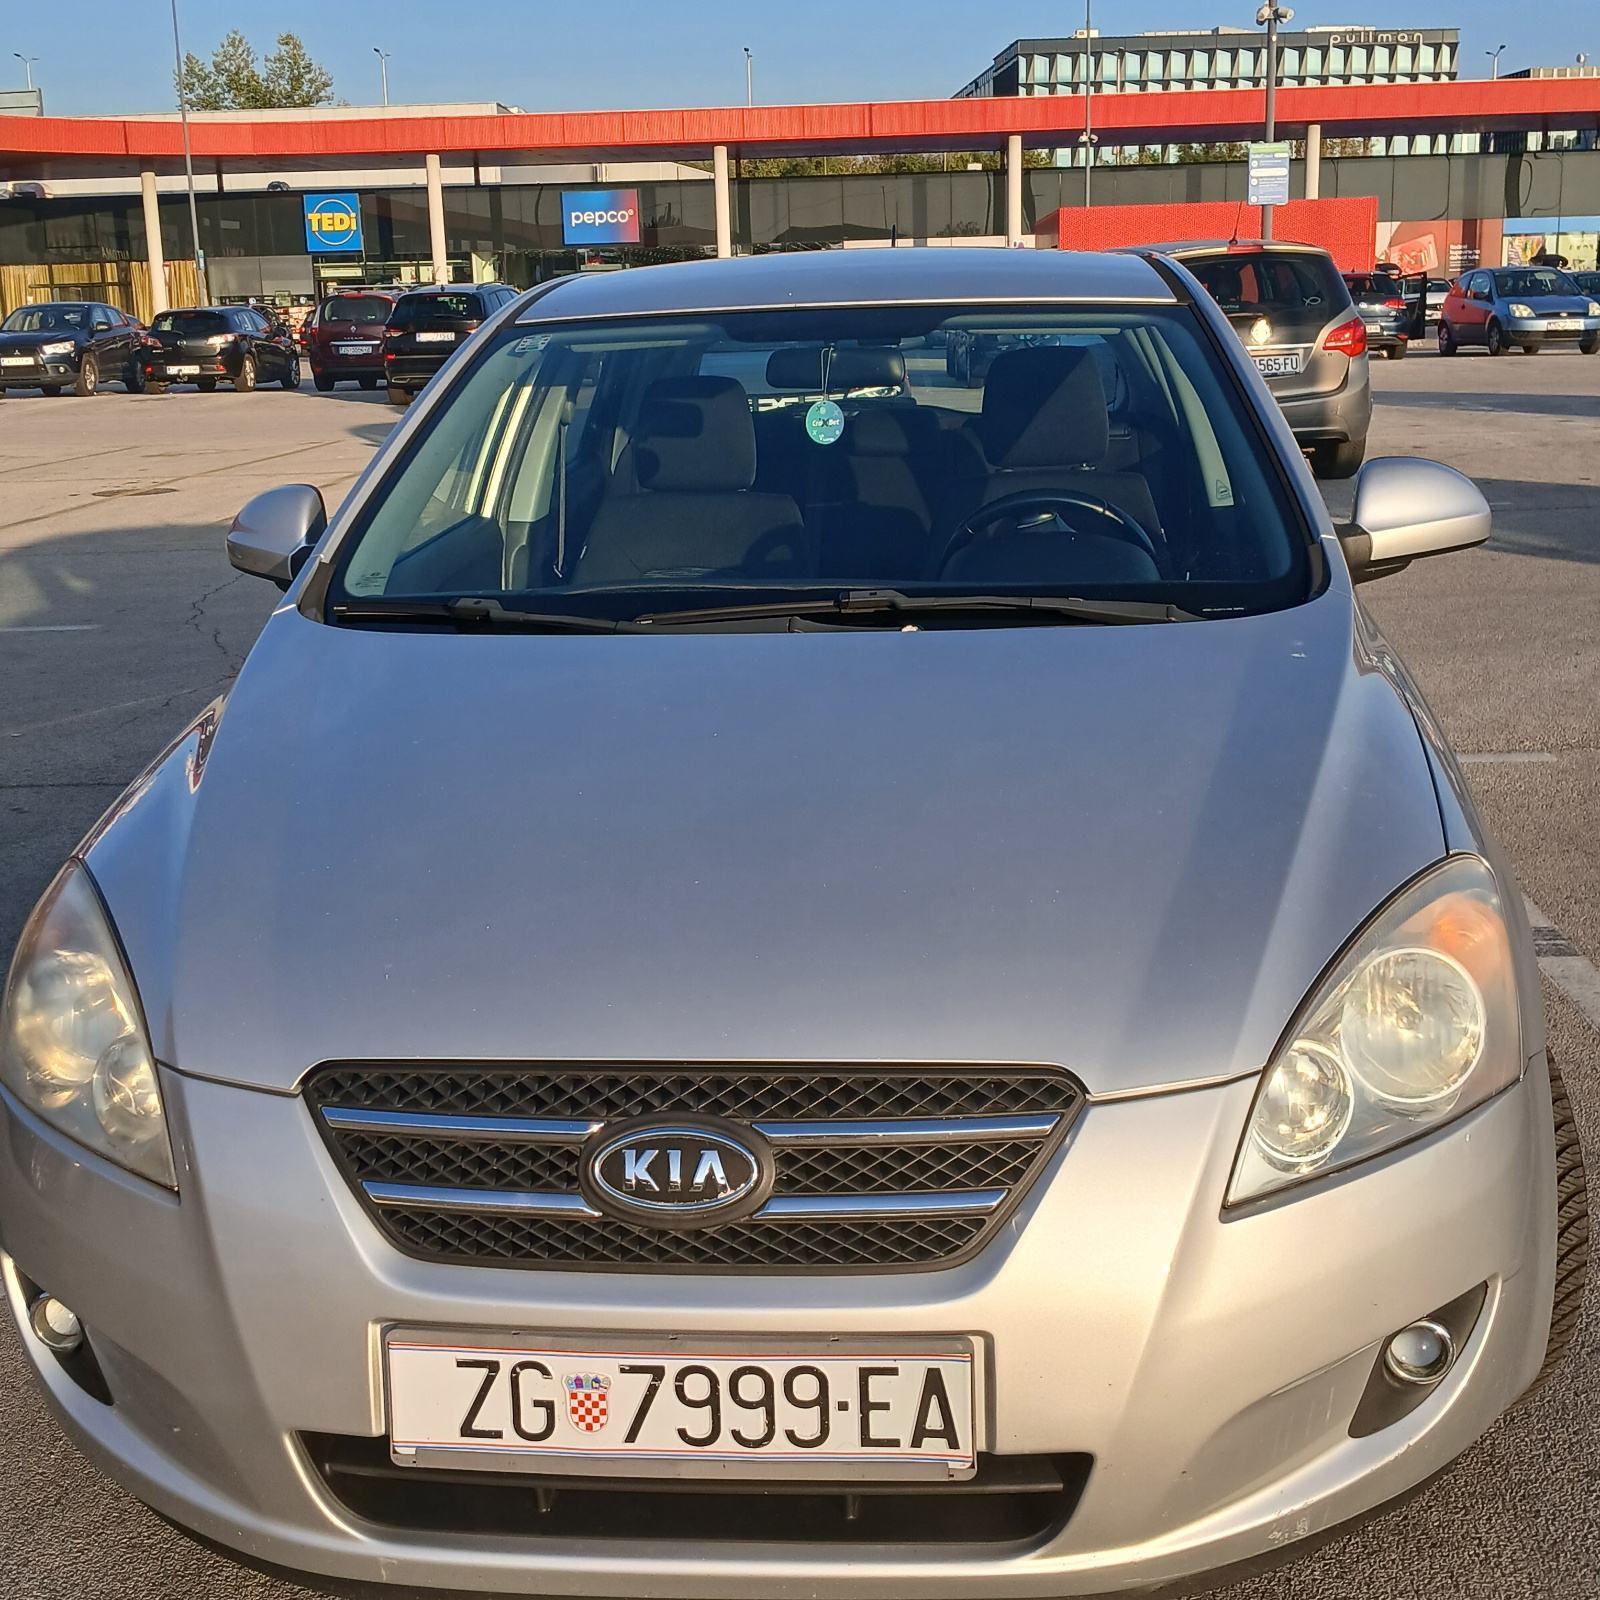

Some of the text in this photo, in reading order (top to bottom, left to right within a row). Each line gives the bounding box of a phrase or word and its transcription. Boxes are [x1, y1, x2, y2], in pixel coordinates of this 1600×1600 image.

[1329, 30, 1423, 48] pullman
[307, 212, 357, 232] TEDi
[571, 210, 629, 227] pepco
[622, 1149, 731, 1194] KIA
[456, 1358, 556, 1442] ZG
